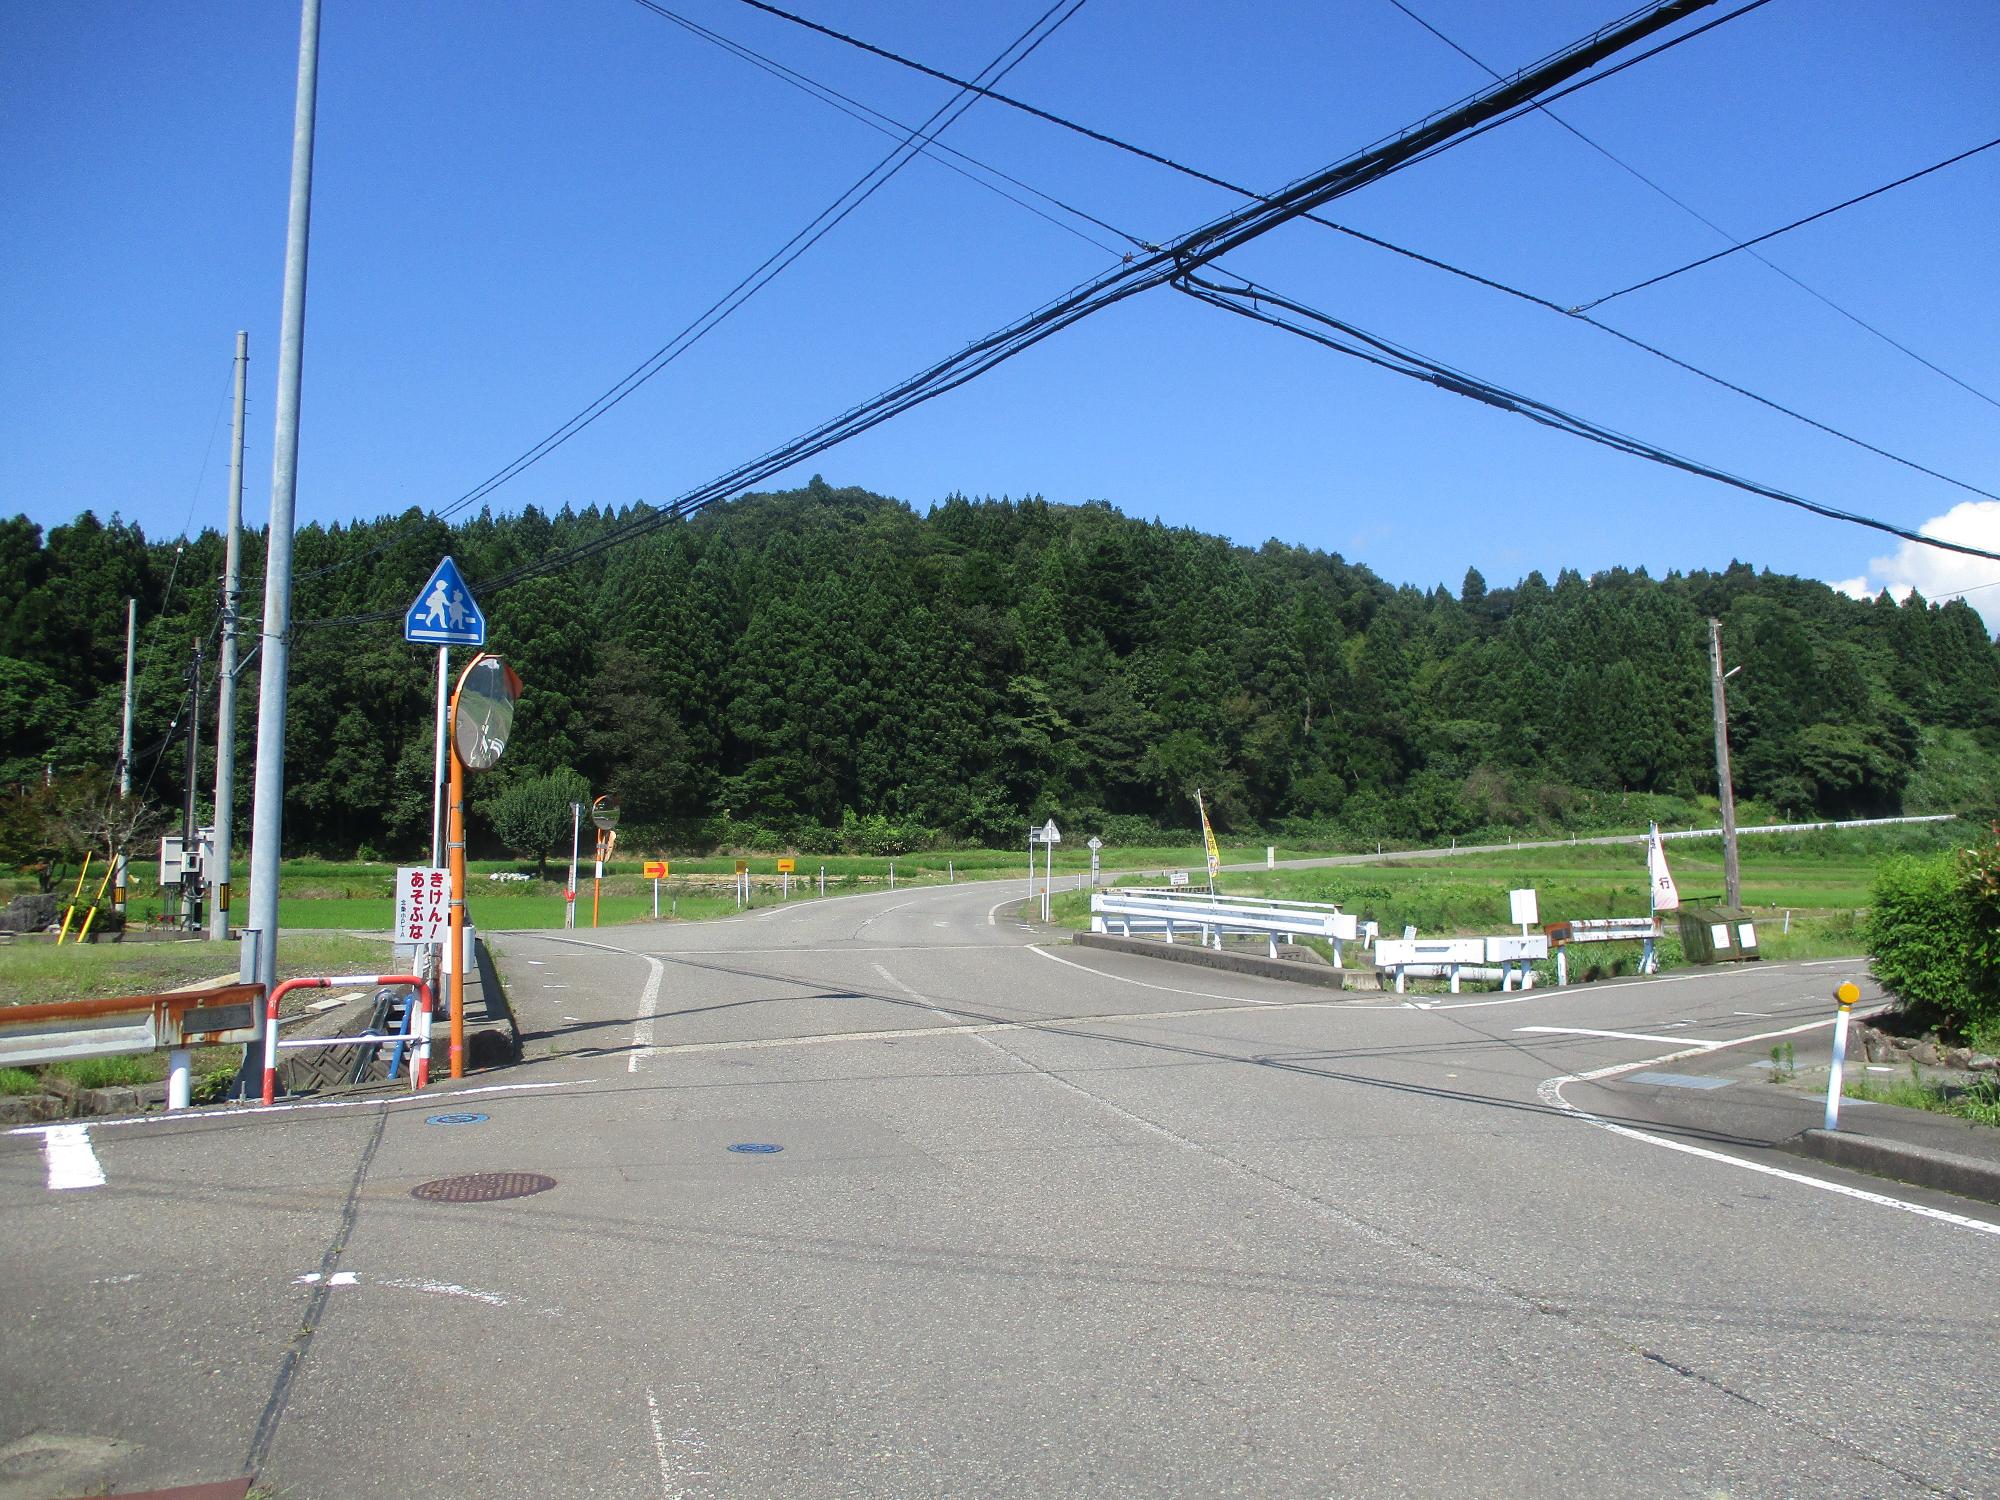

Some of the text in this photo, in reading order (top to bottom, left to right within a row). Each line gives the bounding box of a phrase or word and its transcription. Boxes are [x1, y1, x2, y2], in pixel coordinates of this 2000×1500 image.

[409, 872, 425, 940] あそぶな
[428, 872, 444, 939] きけん!
